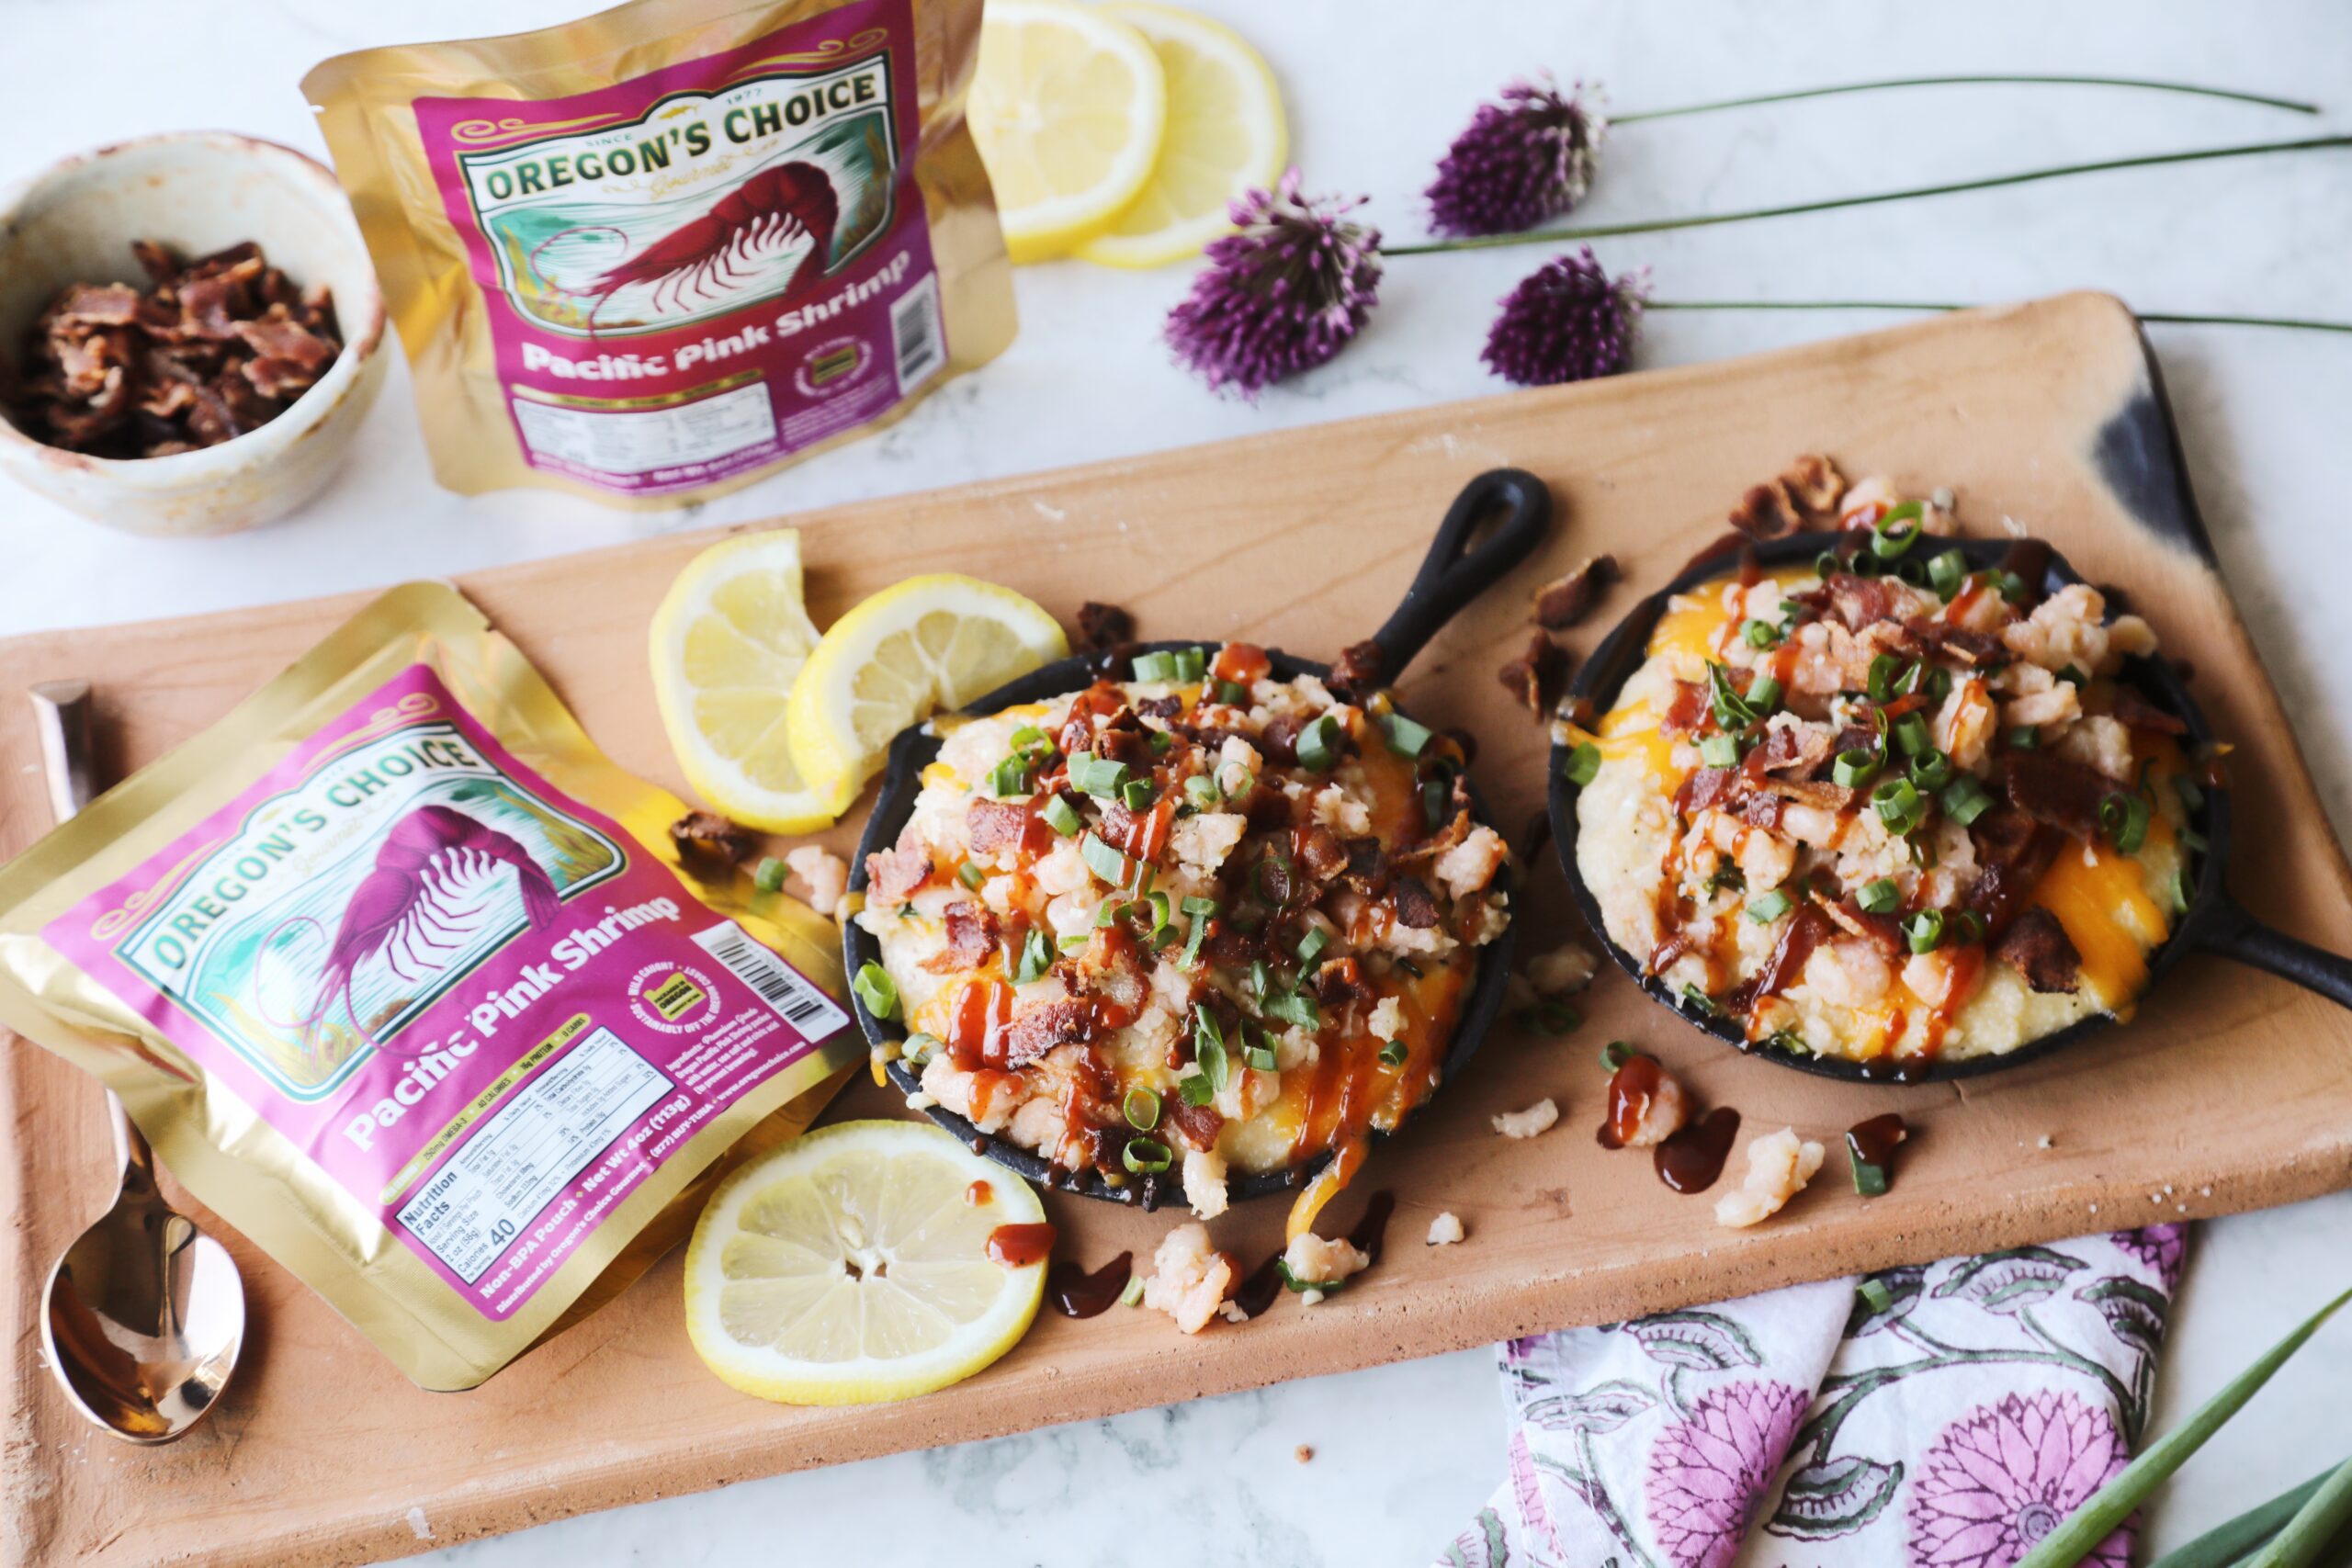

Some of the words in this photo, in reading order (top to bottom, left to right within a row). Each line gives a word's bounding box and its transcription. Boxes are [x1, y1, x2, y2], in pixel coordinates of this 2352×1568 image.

[485, 120, 711, 200] OREGON'S
[724, 73, 877, 144] CHOICE
[585, 133, 632, 148] SINCE
[726, 88, 762, 106] 1977
[521, 342, 669, 380] Pacific
[673, 324, 771, 369] Pink
[776, 250, 910, 337] Shrimp
[153, 807, 328, 971] OREGON'S
[326, 739, 480, 808] CHOICE
[639, 961, 673, 978] CAUGHT
[660, 985, 693, 1009] OREGON
[343, 1032, 479, 1153] Pacific
[465, 963, 564, 1038] Pink
[550, 896, 681, 971] Shrimp
[630, 1003, 683, 1034] SUSTAINABLY
[684, 1021, 701, 1033] OFF
[440, 1115, 469, 1143] OMEGA-3
[476, 1099, 487, 1109] 40
[483, 1076, 512, 1102] CALORIES
[528, 1040, 554, 1065] PROTEIN
[566, 1015, 585, 1033] CARBS
[401, 1168, 459, 1226] Nutrition
[479, 1236, 539, 1299] Non-BPA
[533, 1195, 578, 1243] Pouch
[581, 1164, 611, 1193] Net
[605, 1146, 630, 1170] Wt
[625, 1124, 653, 1151] 4oz
[648, 1091, 692, 1132] (113g)
[495, 1264, 544, 1314] Distributed
[539, 1255, 554, 1269] by
[549, 1219, 587, 1258] Oregon's
[582, 1191, 613, 1223] Choice
[609, 1160, 647, 1197] Gourmet
[649, 1134, 675, 1159] (877)
[671, 1101, 714, 1139] BUY-TUNA
[715, 1037, 807, 1103] www.oregonschoice.com
[413, 1198, 451, 1236] Facts
[435, 1224, 467, 1255] Serving
[460, 1208, 480, 1226] Size
[444, 1253, 454, 1263] 2
[450, 1244, 463, 1257] oz
[458, 1224, 481, 1248] (56g)
[456, 1240, 490, 1274] Calories
[484, 1215, 517, 1248] 40
